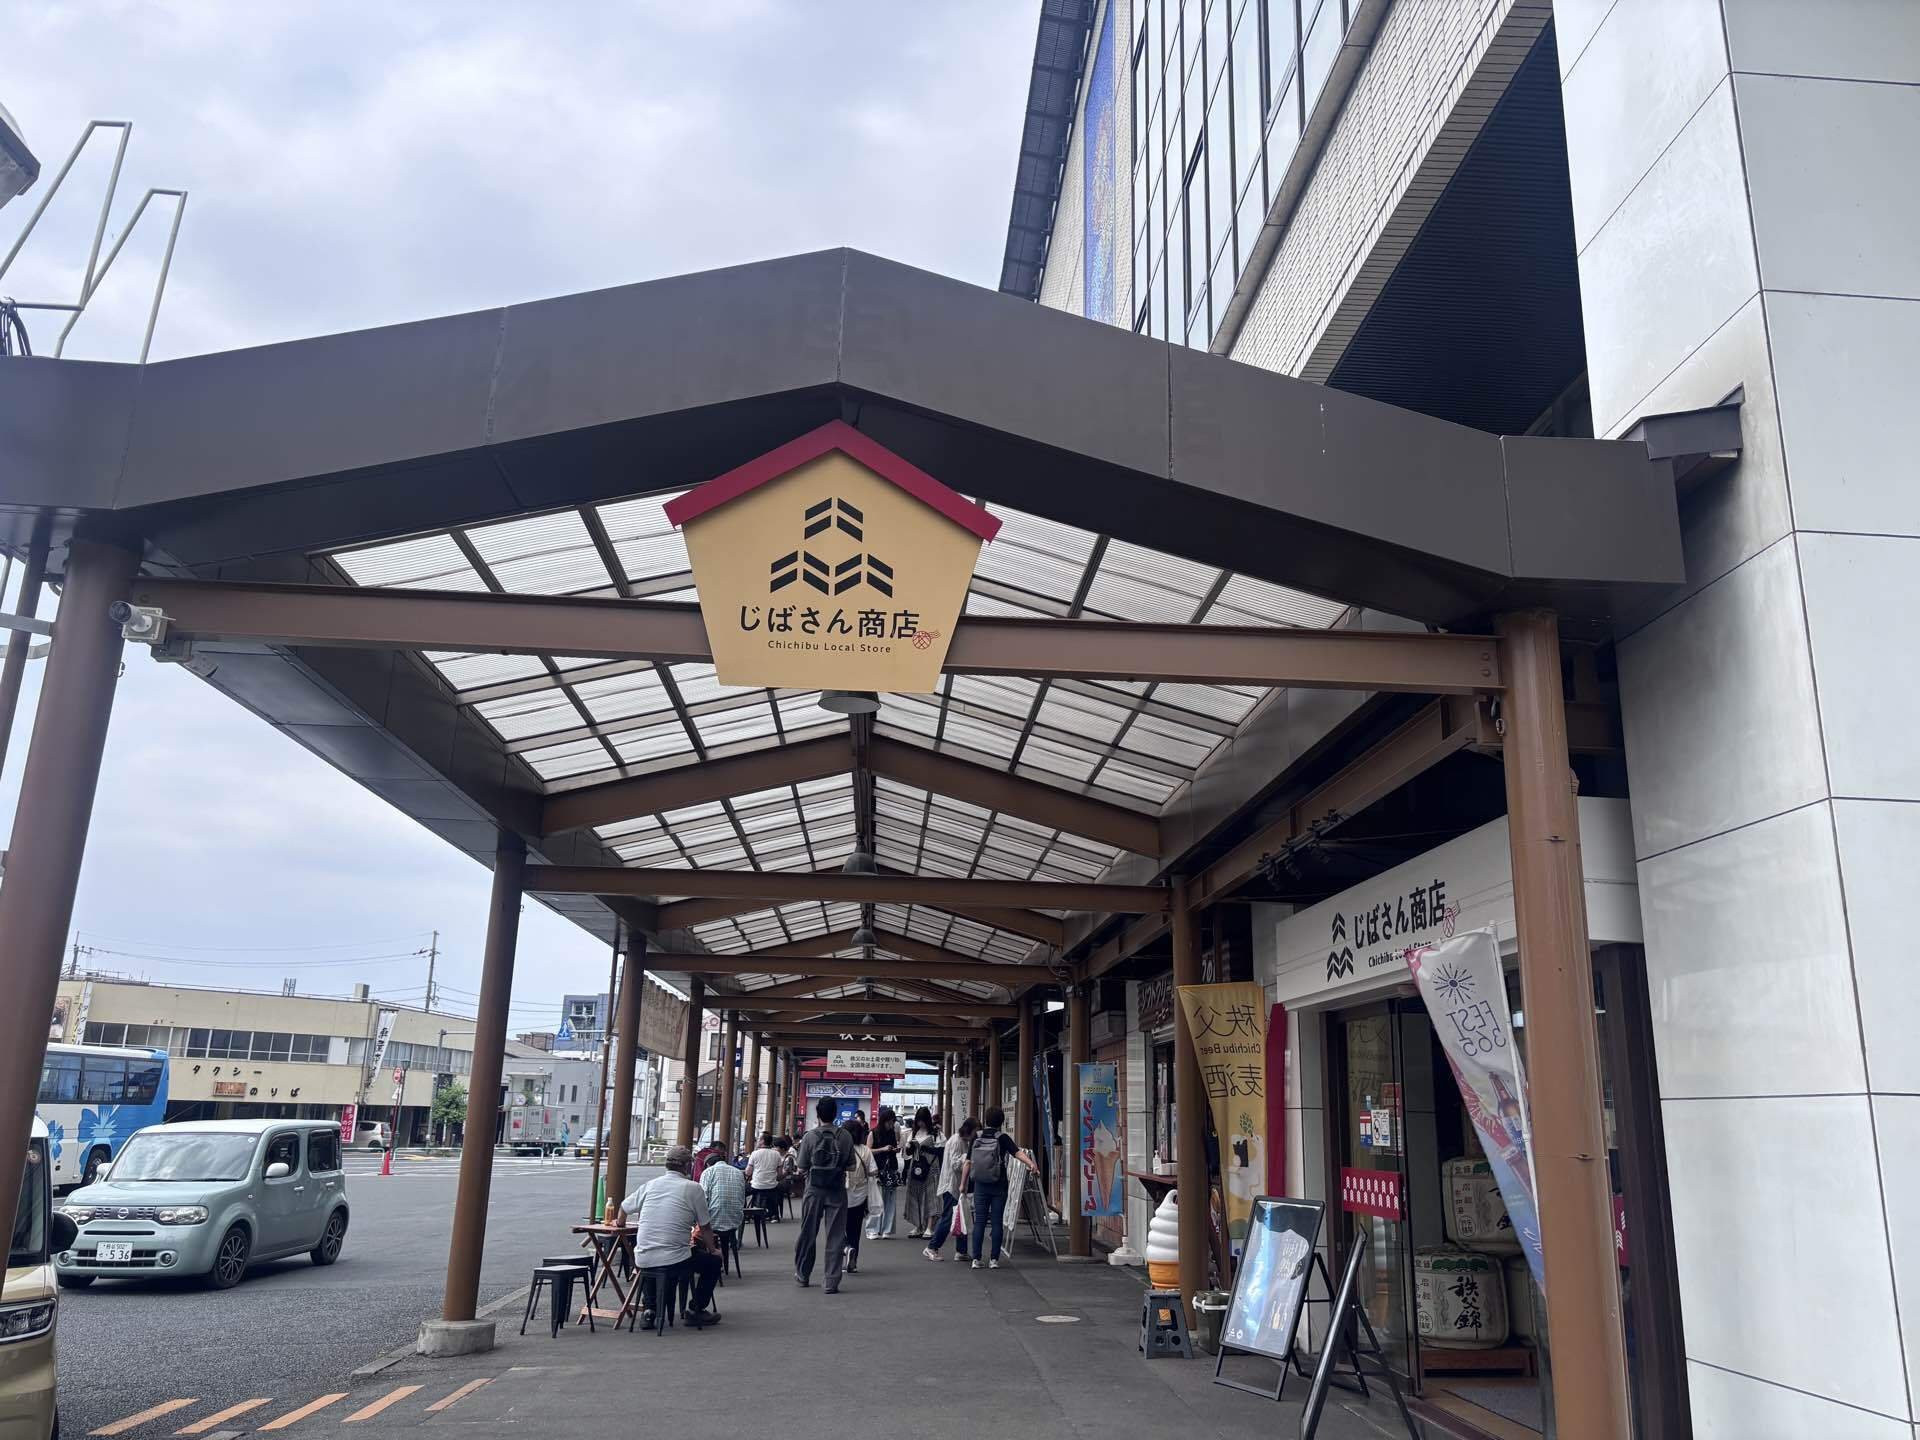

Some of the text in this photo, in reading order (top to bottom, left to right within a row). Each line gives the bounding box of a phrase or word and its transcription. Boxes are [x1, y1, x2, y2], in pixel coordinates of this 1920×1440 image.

[740, 605, 920, 639] じばさん商店
[768, 640, 891, 653] Chichibu Local Store
[1354, 879, 1446, 950] じばさん商店
[193, 1064, 262, 1076] タクシー
[250, 1087, 300, 1097] のりば
[1448, 1274, 1483, 1340] 秩父錦
